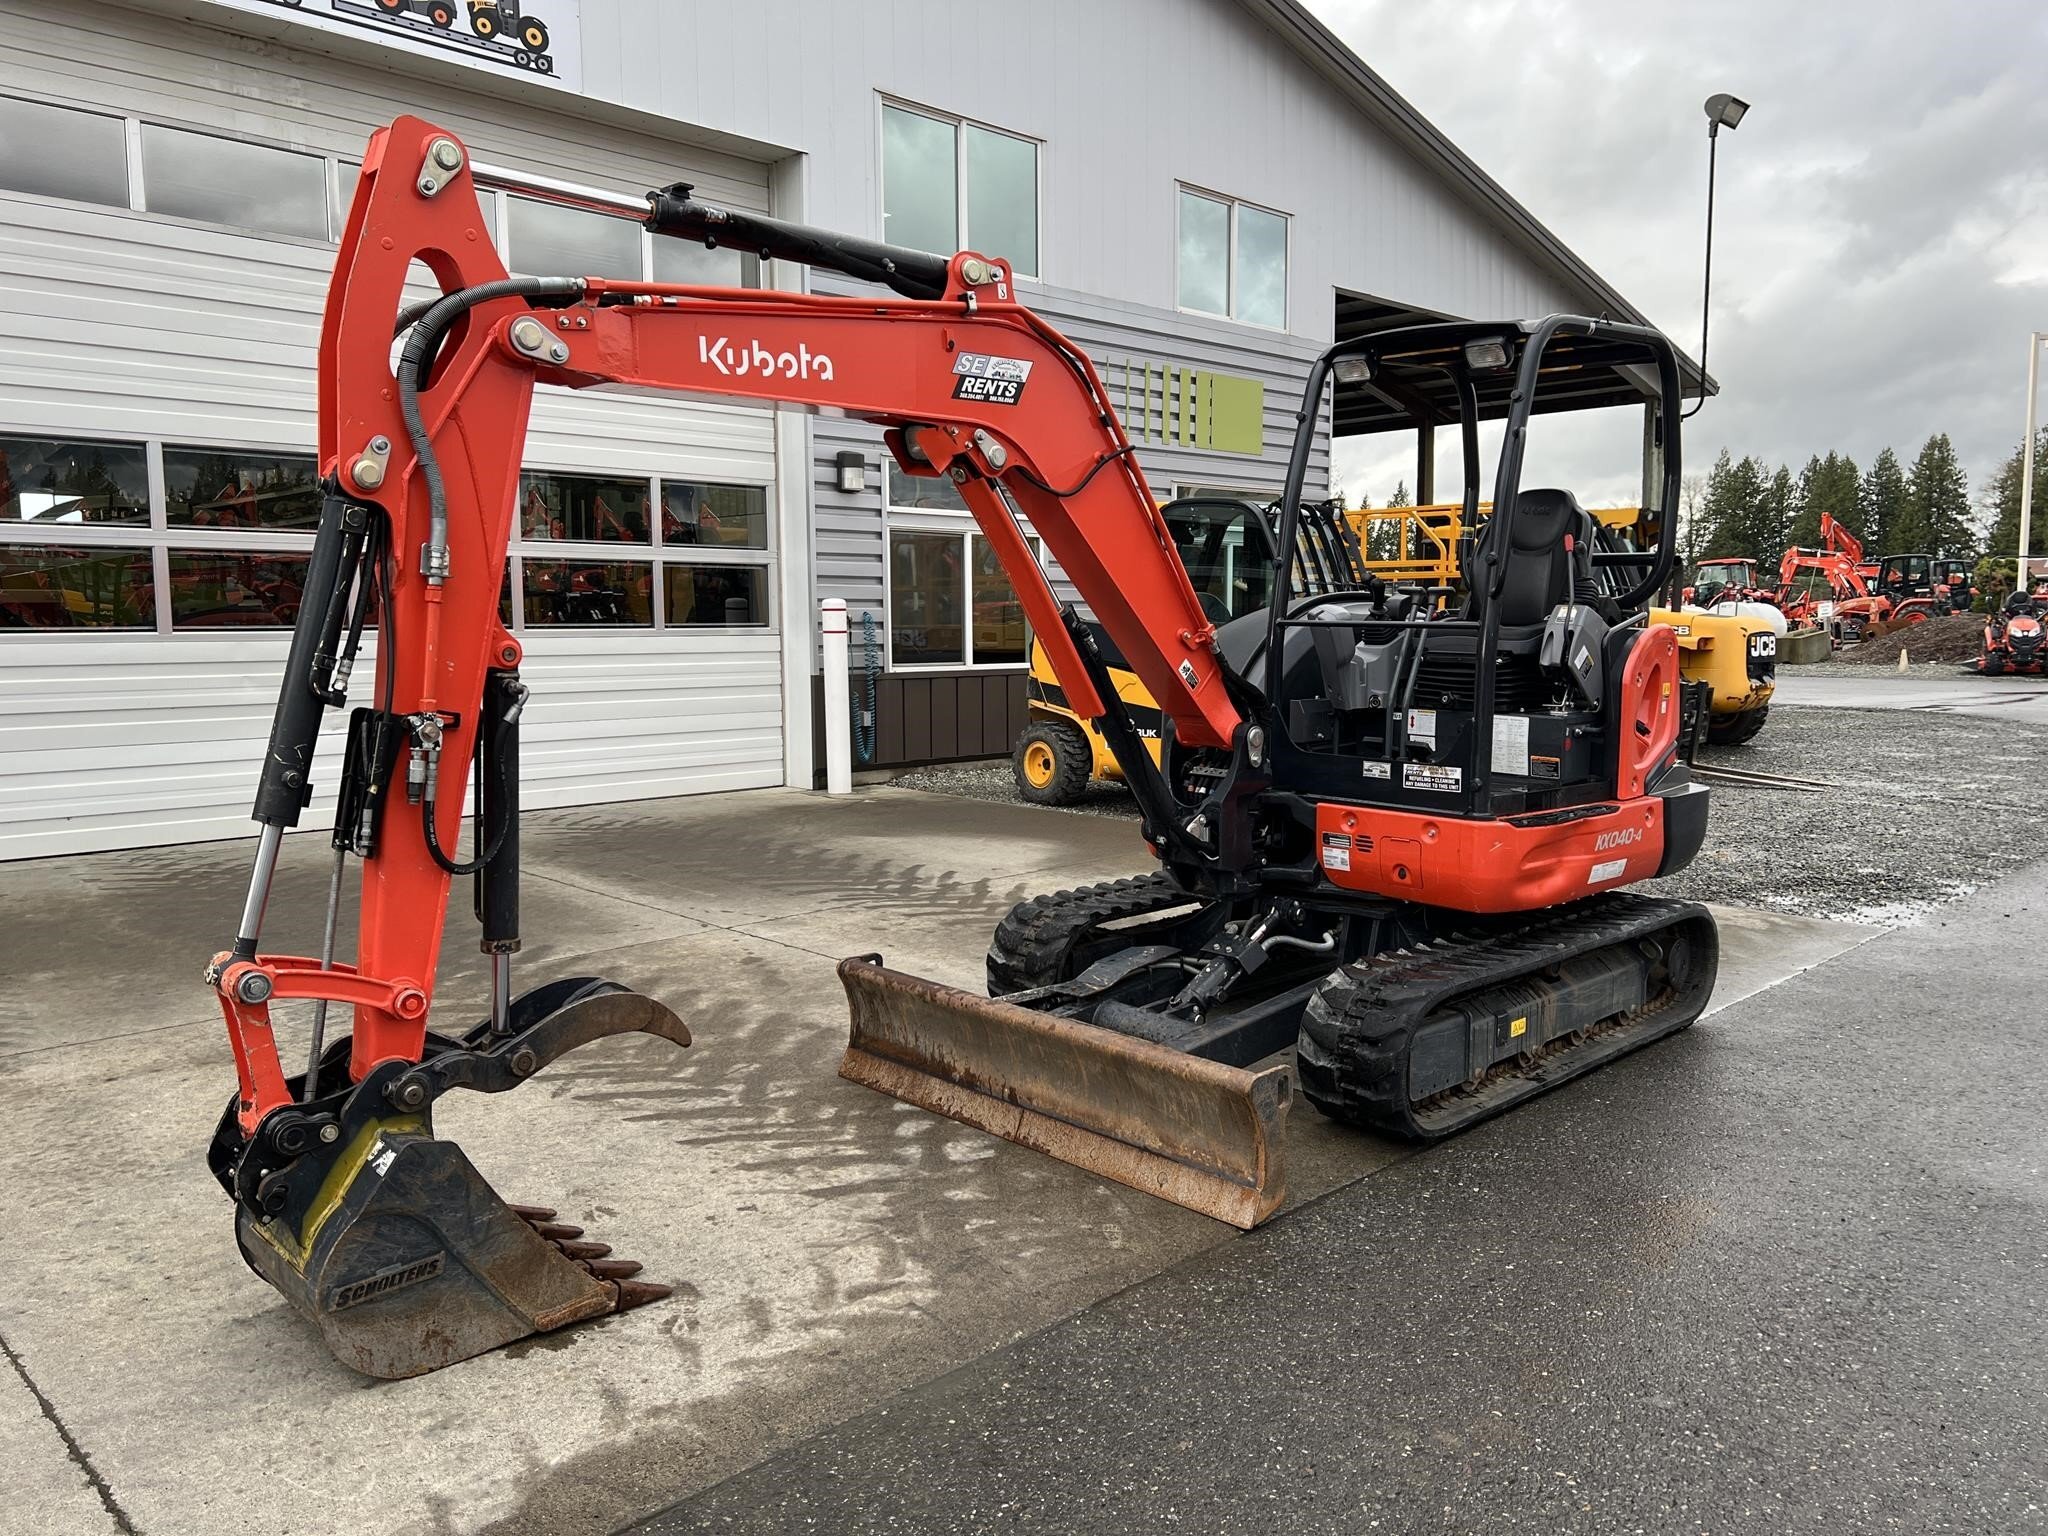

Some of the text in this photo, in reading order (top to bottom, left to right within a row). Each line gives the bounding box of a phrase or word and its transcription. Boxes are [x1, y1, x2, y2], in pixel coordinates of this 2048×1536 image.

[699, 335, 834, 381] Kubota
[957, 355, 986, 374] SE
[961, 377, 1018, 397] RENTS
[1672, 626, 1690, 635] CB
[1751, 635, 1776, 657] JCB
[1136, 728, 1157, 738] RUK
[1594, 827, 1643, 852] KX040-4
[335, 1259, 440, 1308] SCHOLTENS
